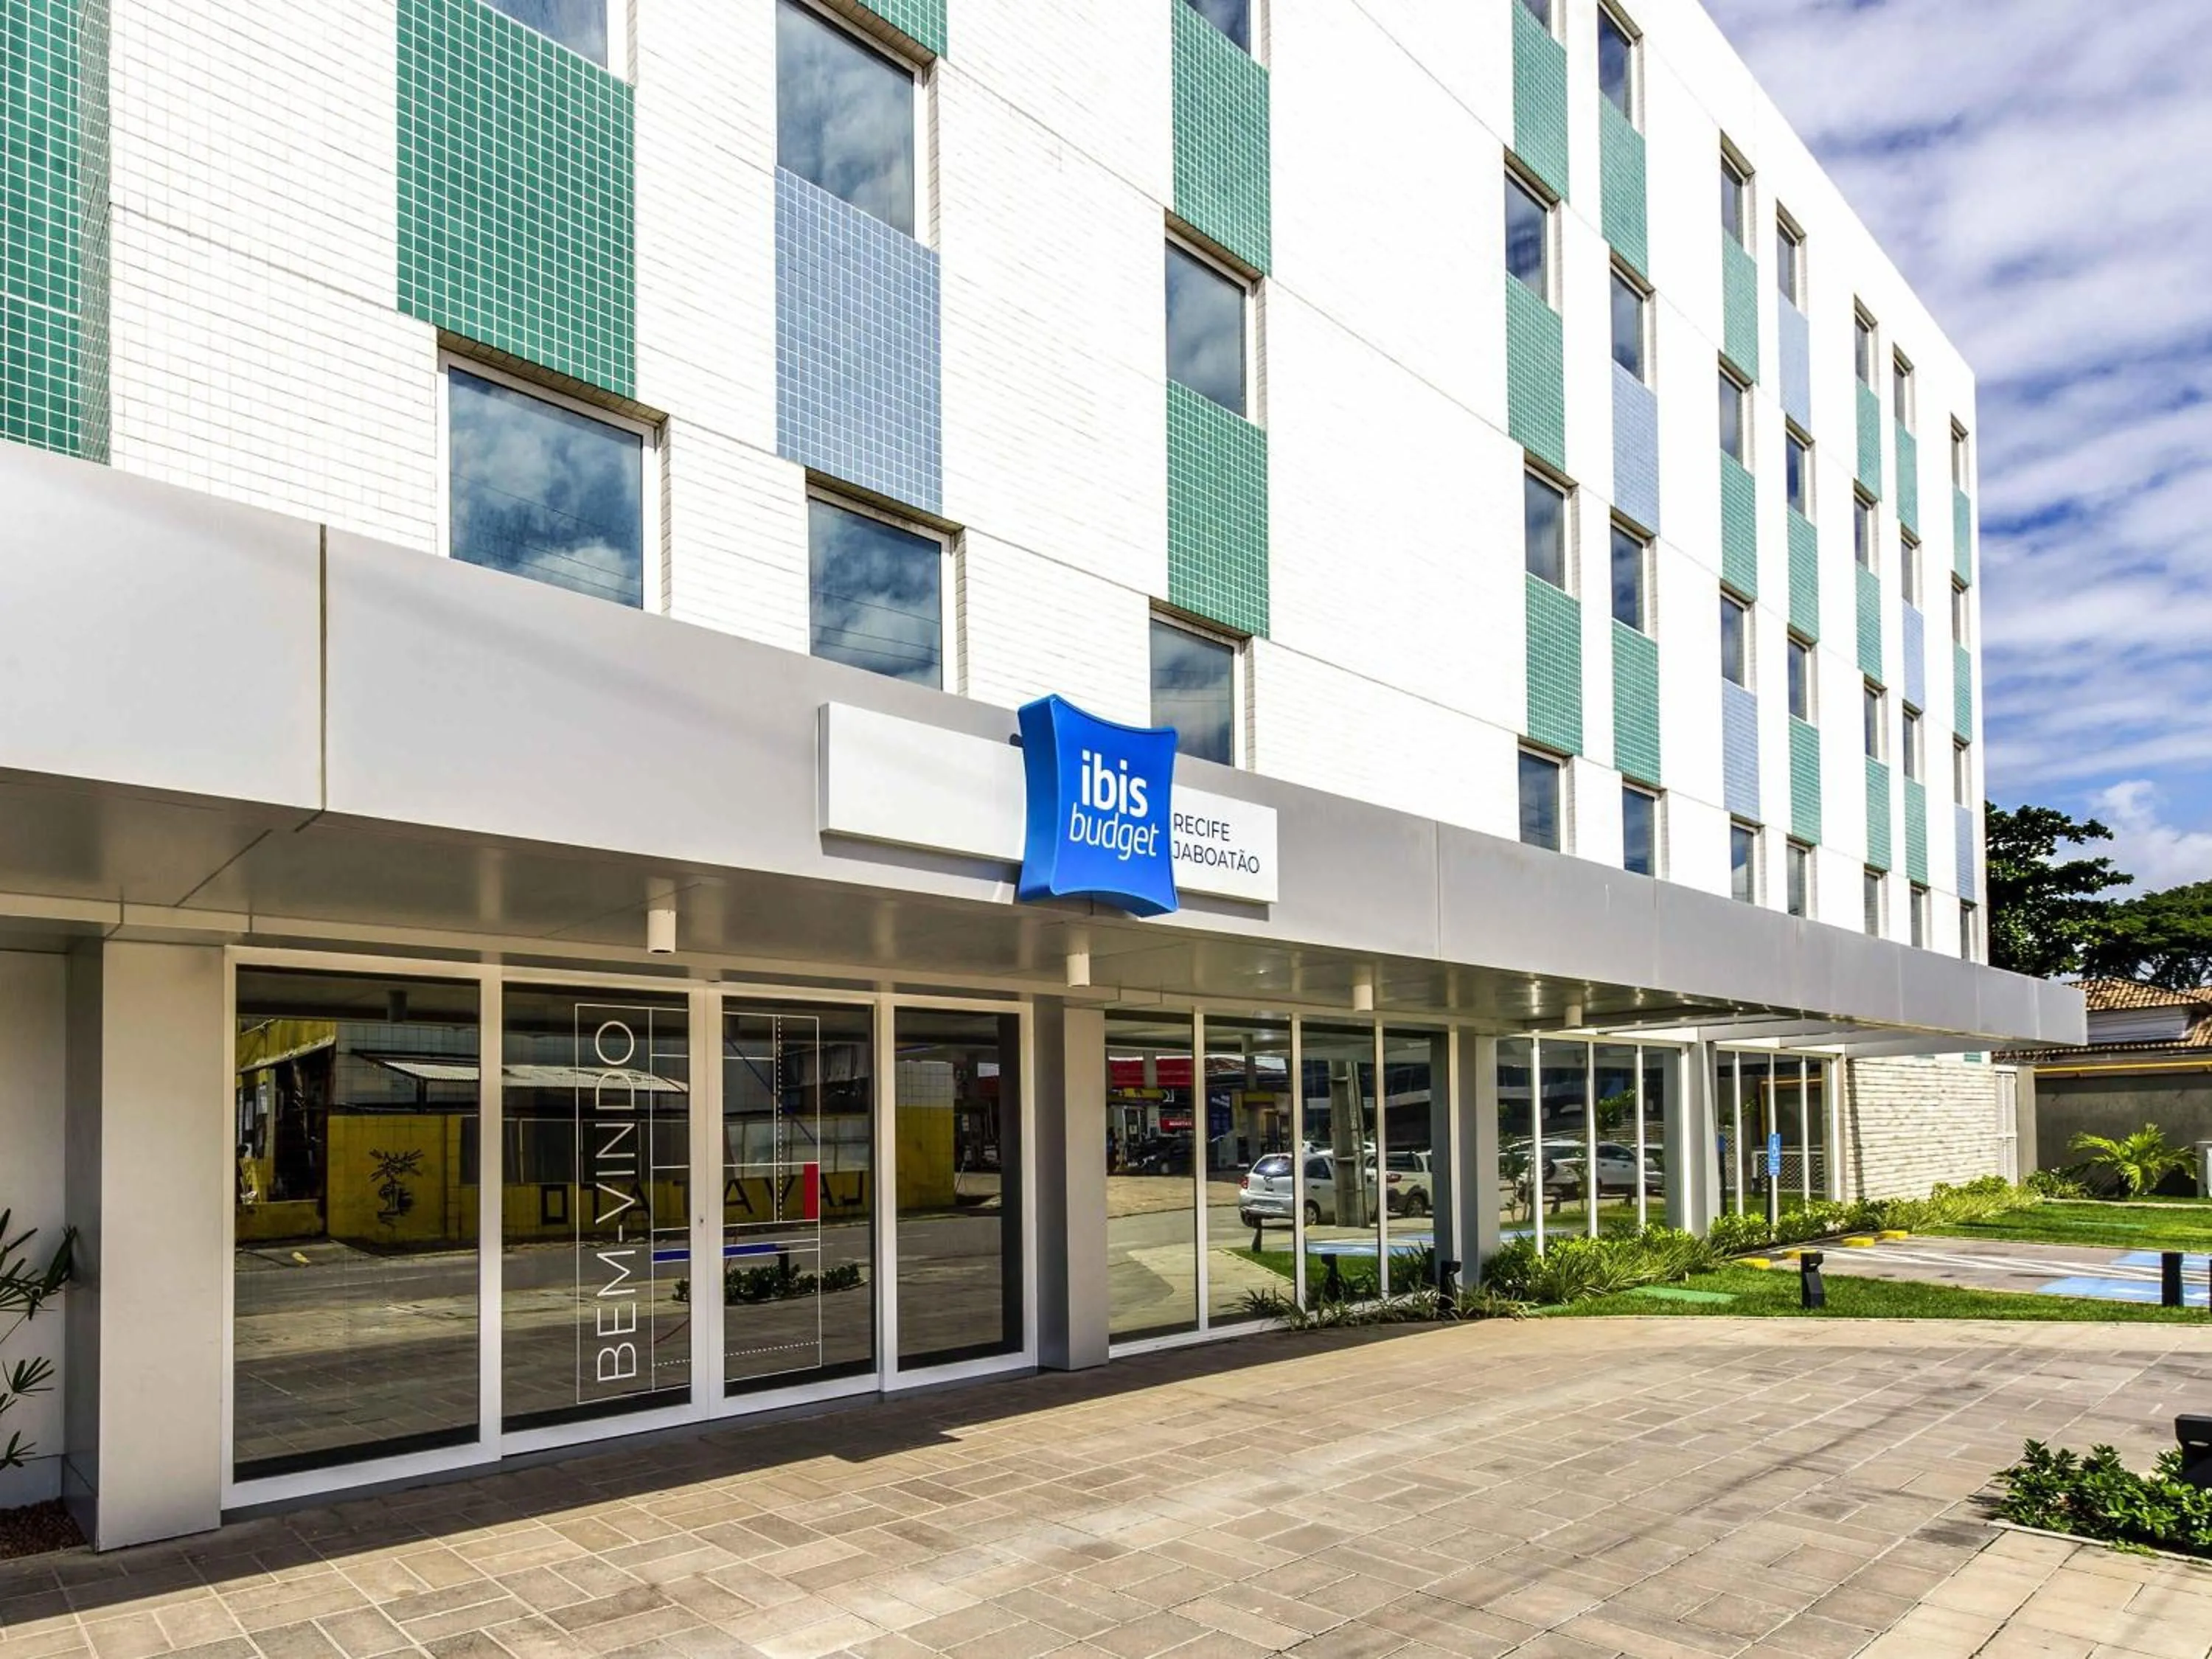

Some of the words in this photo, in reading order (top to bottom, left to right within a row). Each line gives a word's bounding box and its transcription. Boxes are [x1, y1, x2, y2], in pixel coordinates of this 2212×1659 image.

[1082, 749, 1148, 818] ibis
[1070, 802, 1159, 860] budget
[1174, 813, 1231, 841] RECIFE
[1174, 841, 1260, 874] JABOATÃO
[595, 1020, 636, 1382] BEM-VINDO
